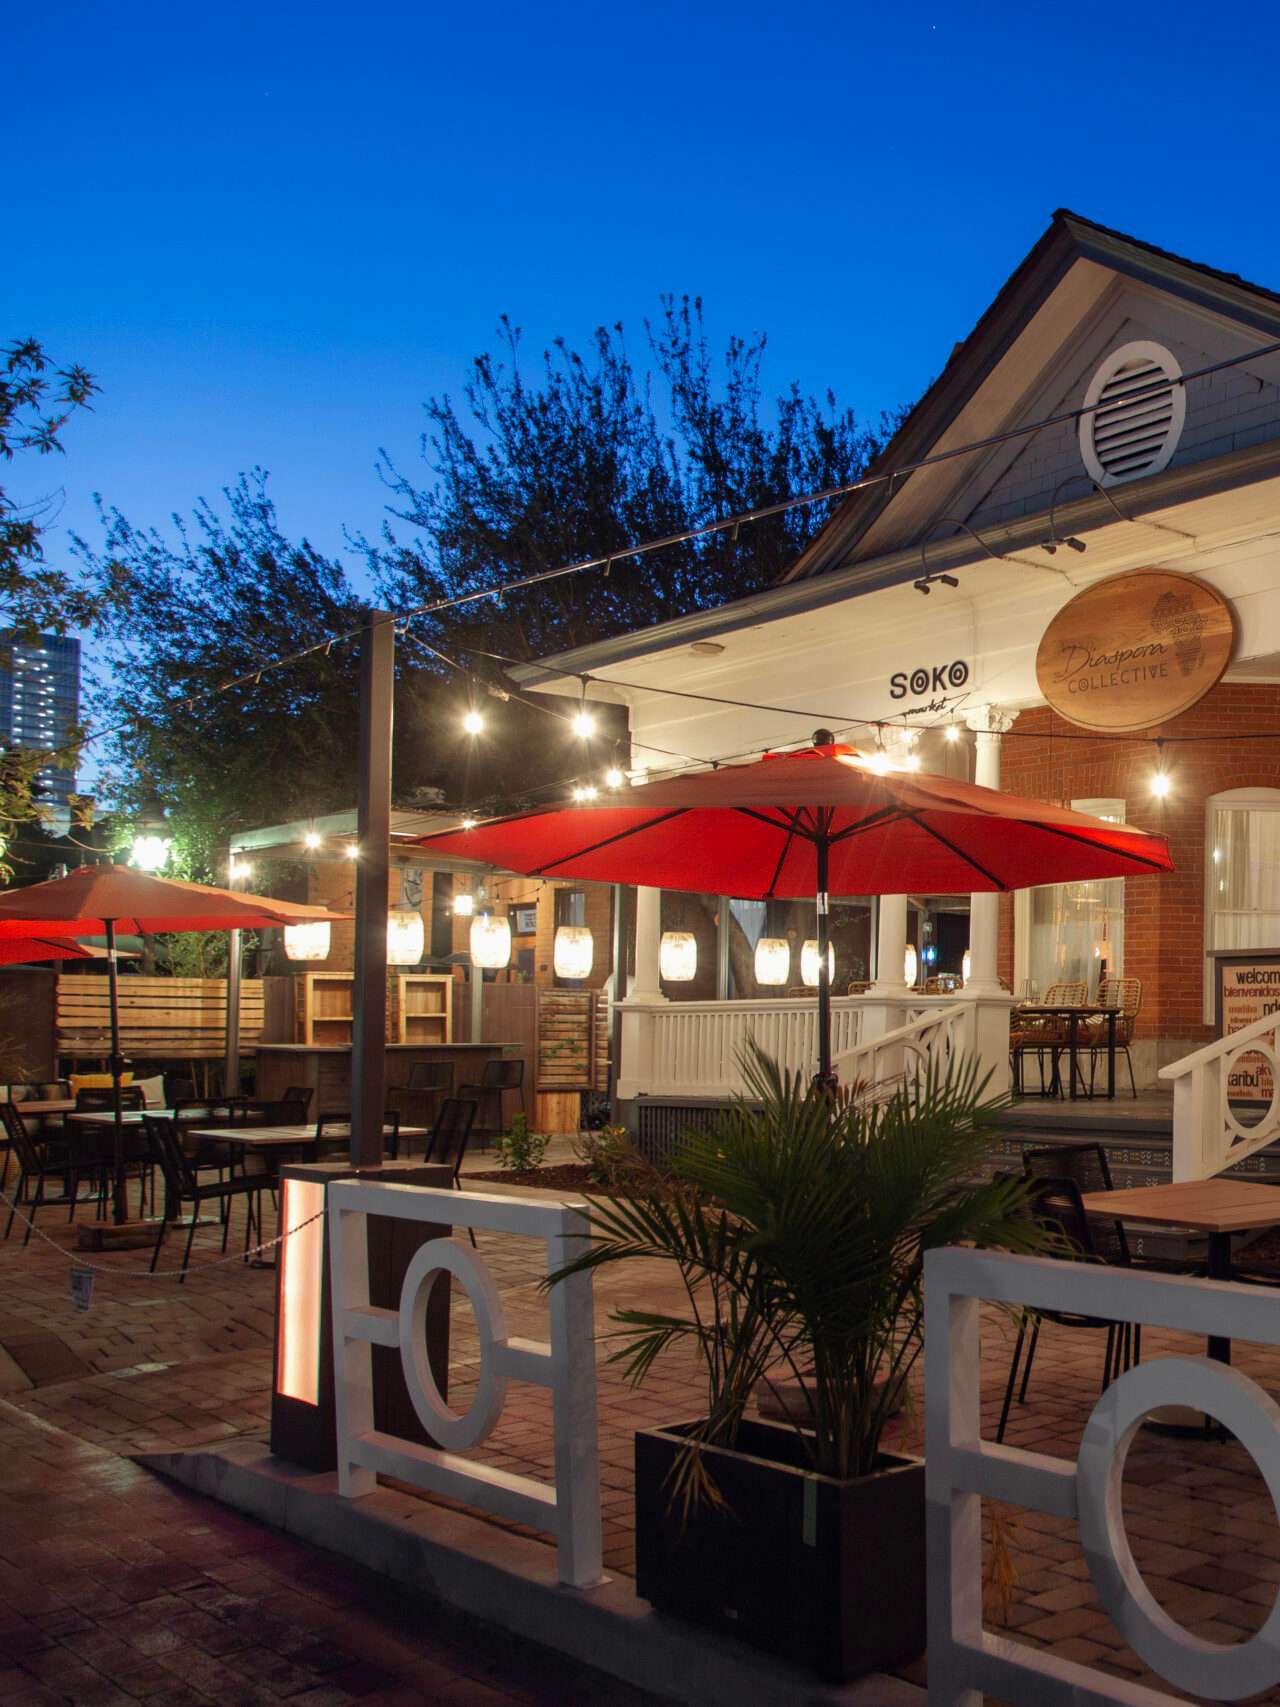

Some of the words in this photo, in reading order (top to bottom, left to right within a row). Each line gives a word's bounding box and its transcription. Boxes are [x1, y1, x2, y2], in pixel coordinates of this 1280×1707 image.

[1053, 641, 1169, 684] Diaspora
[1067, 662, 1170, 694] COLLECTIVE
[889, 659, 969, 699] SOKO
[907, 696, 947, 714] market
[1224, 985, 1280, 997] bienvenidos
